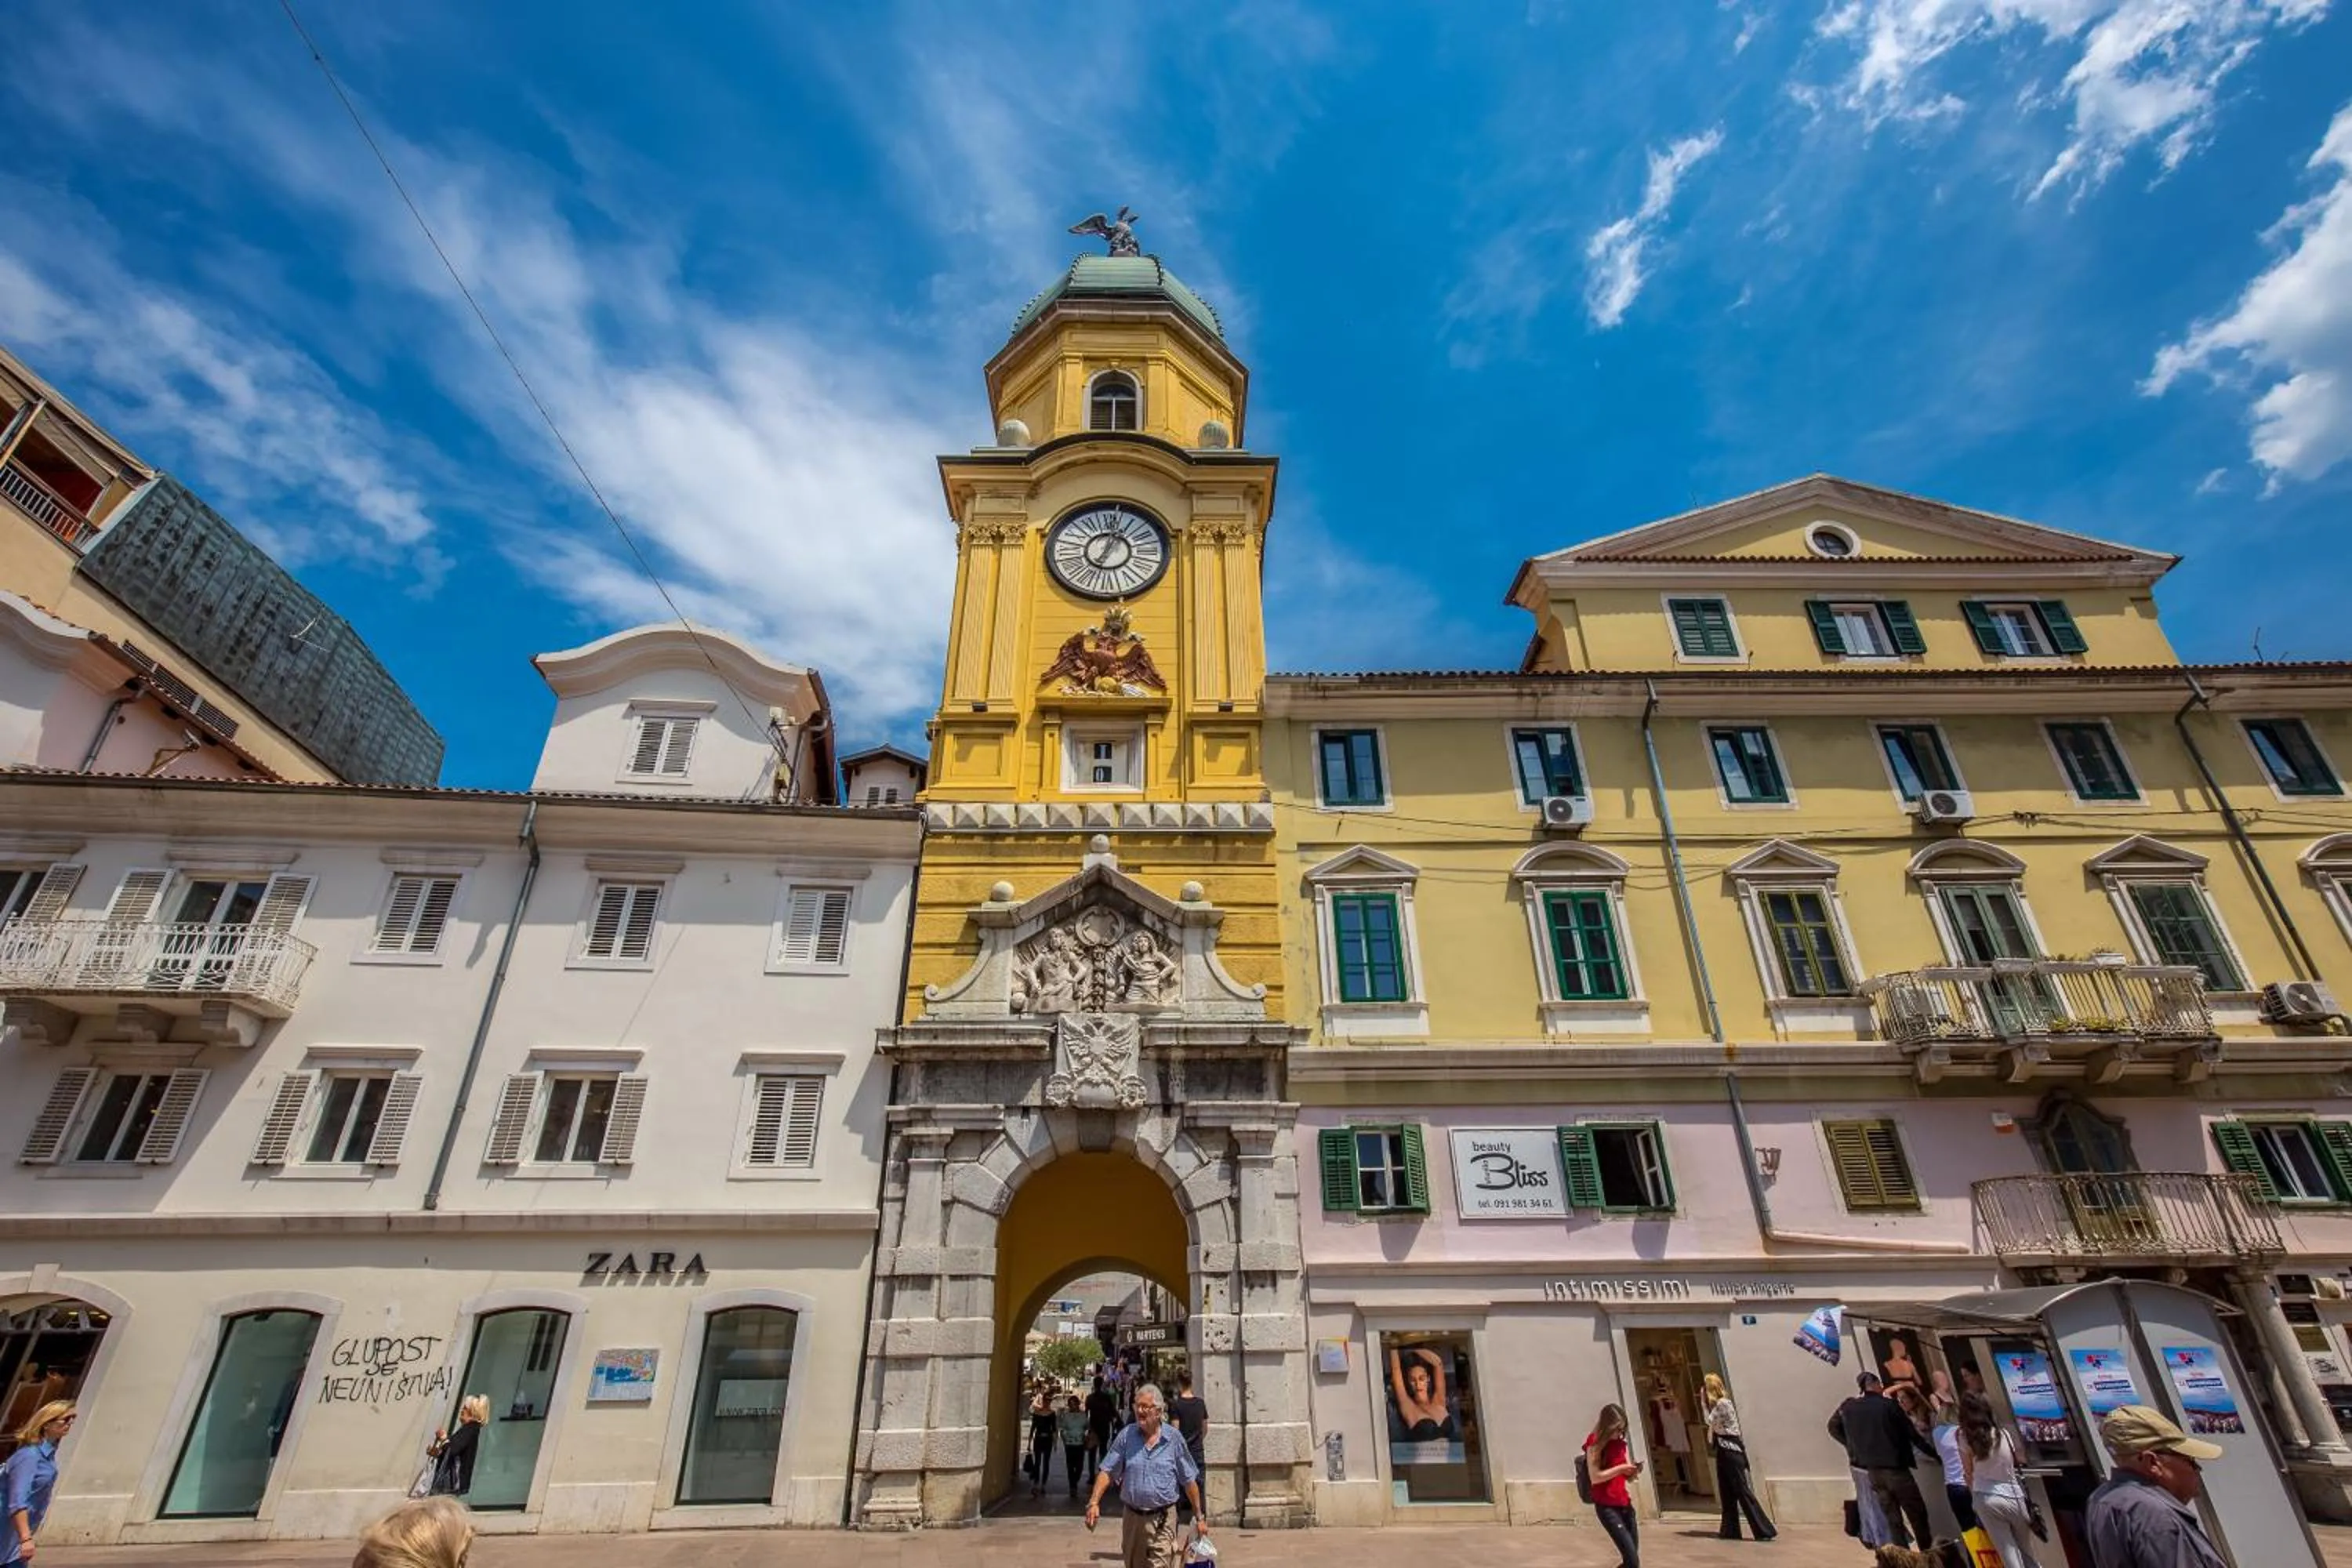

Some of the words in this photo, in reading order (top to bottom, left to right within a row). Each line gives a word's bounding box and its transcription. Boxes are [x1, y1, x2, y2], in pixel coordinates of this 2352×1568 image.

[1472, 1141, 1512, 1152] beauty
[1470, 1152, 1548, 1190] Bliss
[583, 1252, 710, 1274] ZARA
[332, 1336, 443, 1366] GLUPOST
